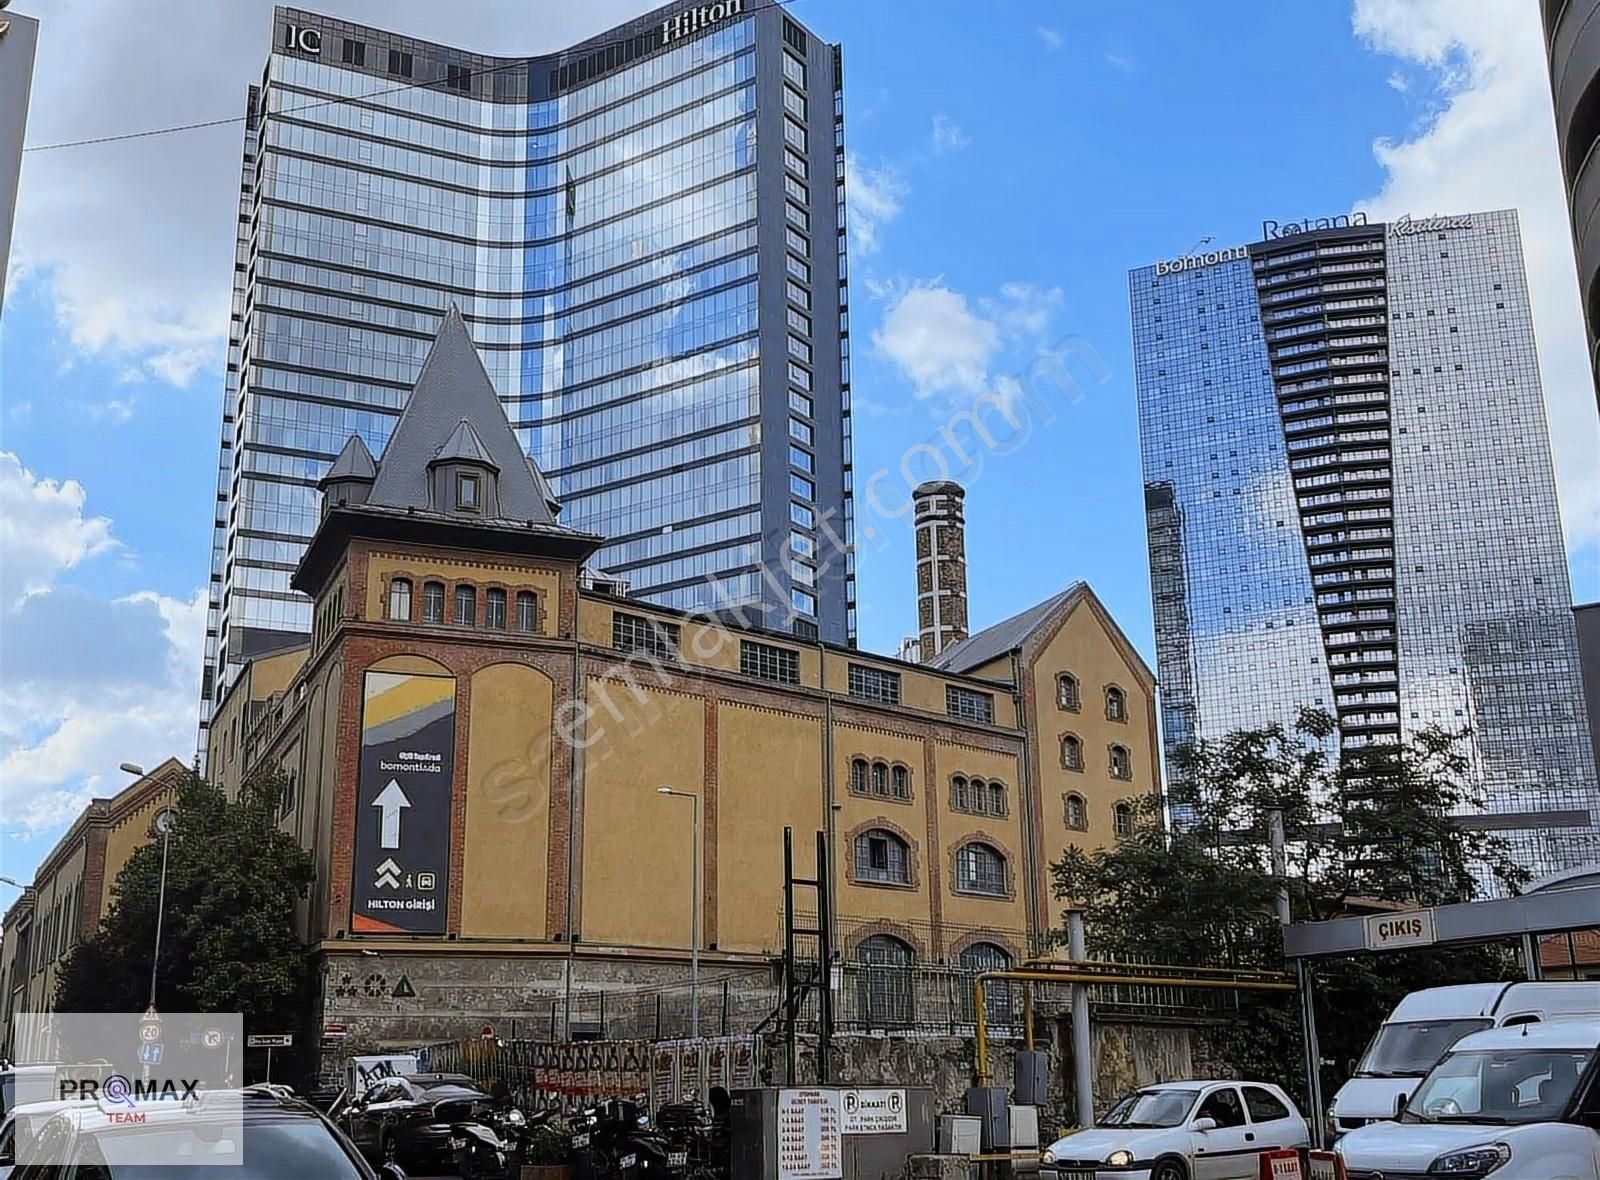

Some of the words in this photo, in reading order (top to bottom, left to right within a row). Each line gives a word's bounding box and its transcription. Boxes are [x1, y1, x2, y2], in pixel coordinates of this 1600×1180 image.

[661, 0, 741, 44] Hilton
[287, 24, 321, 53] IC
[1262, 211, 1367, 242] Rotana
[1378, 918, 1423, 941] ÇIKIŞ
